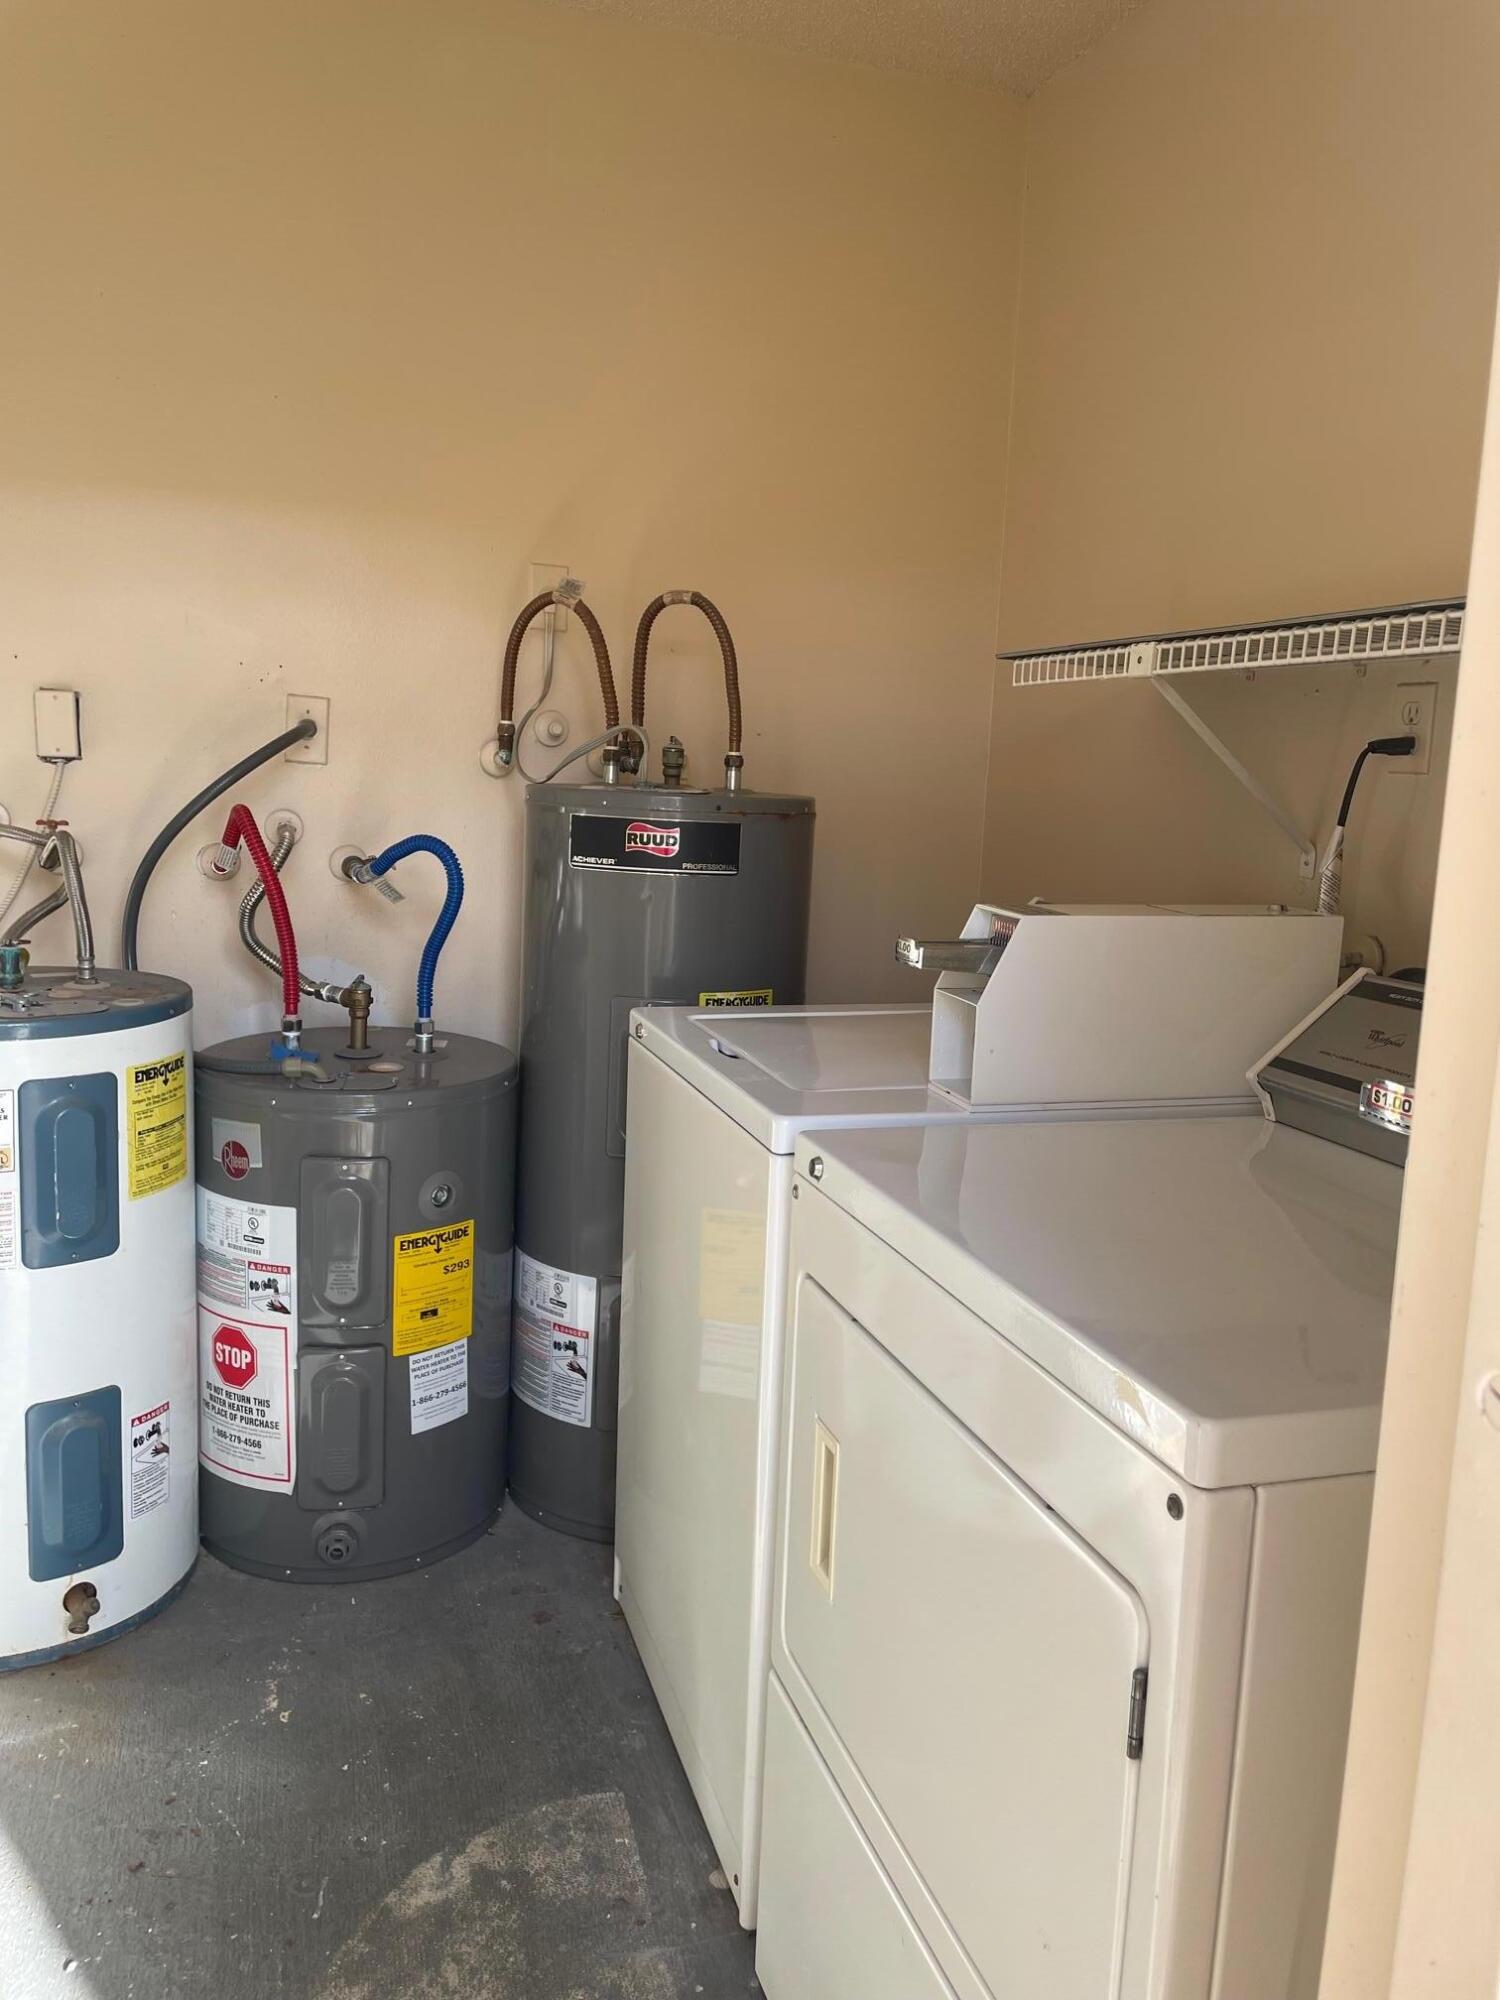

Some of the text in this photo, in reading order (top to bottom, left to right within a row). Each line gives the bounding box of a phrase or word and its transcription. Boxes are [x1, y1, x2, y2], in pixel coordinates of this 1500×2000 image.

[627, 832, 678, 847] RUUD
[682, 862, 737, 871] PROFESSIONAL
[135, 1056, 185, 1084] ENERGYGUIDE
[224, 1141, 249, 1173] Rheem
[400, 1226, 469, 1252] ENERGYGUIDE
[256, 1264, 288, 1273] DANGER
[443, 1259, 470, 1275] $293
[216, 1342, 251, 1369] STOP
[411, 1364, 429, 1373] WATER
[431, 1357, 449, 1366] HEATER
[422, 1355, 433, 1363] NOT
[434, 1348, 454, 1358] RETURN
[414, 1371, 430, 1379] PLACE
[439, 1358, 464, 1371] PURCHASE
[209, 1393, 266, 1418] WATER HEATER TO
[213, 1385, 223, 1396] NOT
[225, 1390, 251, 1404] RETURN
[253, 1397, 271, 1408] THIS
[141, 1404, 168, 1422] DANGER
[211, 1404, 228, 1419] PLACE
[229, 1412, 237, 1422] OF
[240, 1415, 280, 1430] PURCHASE
